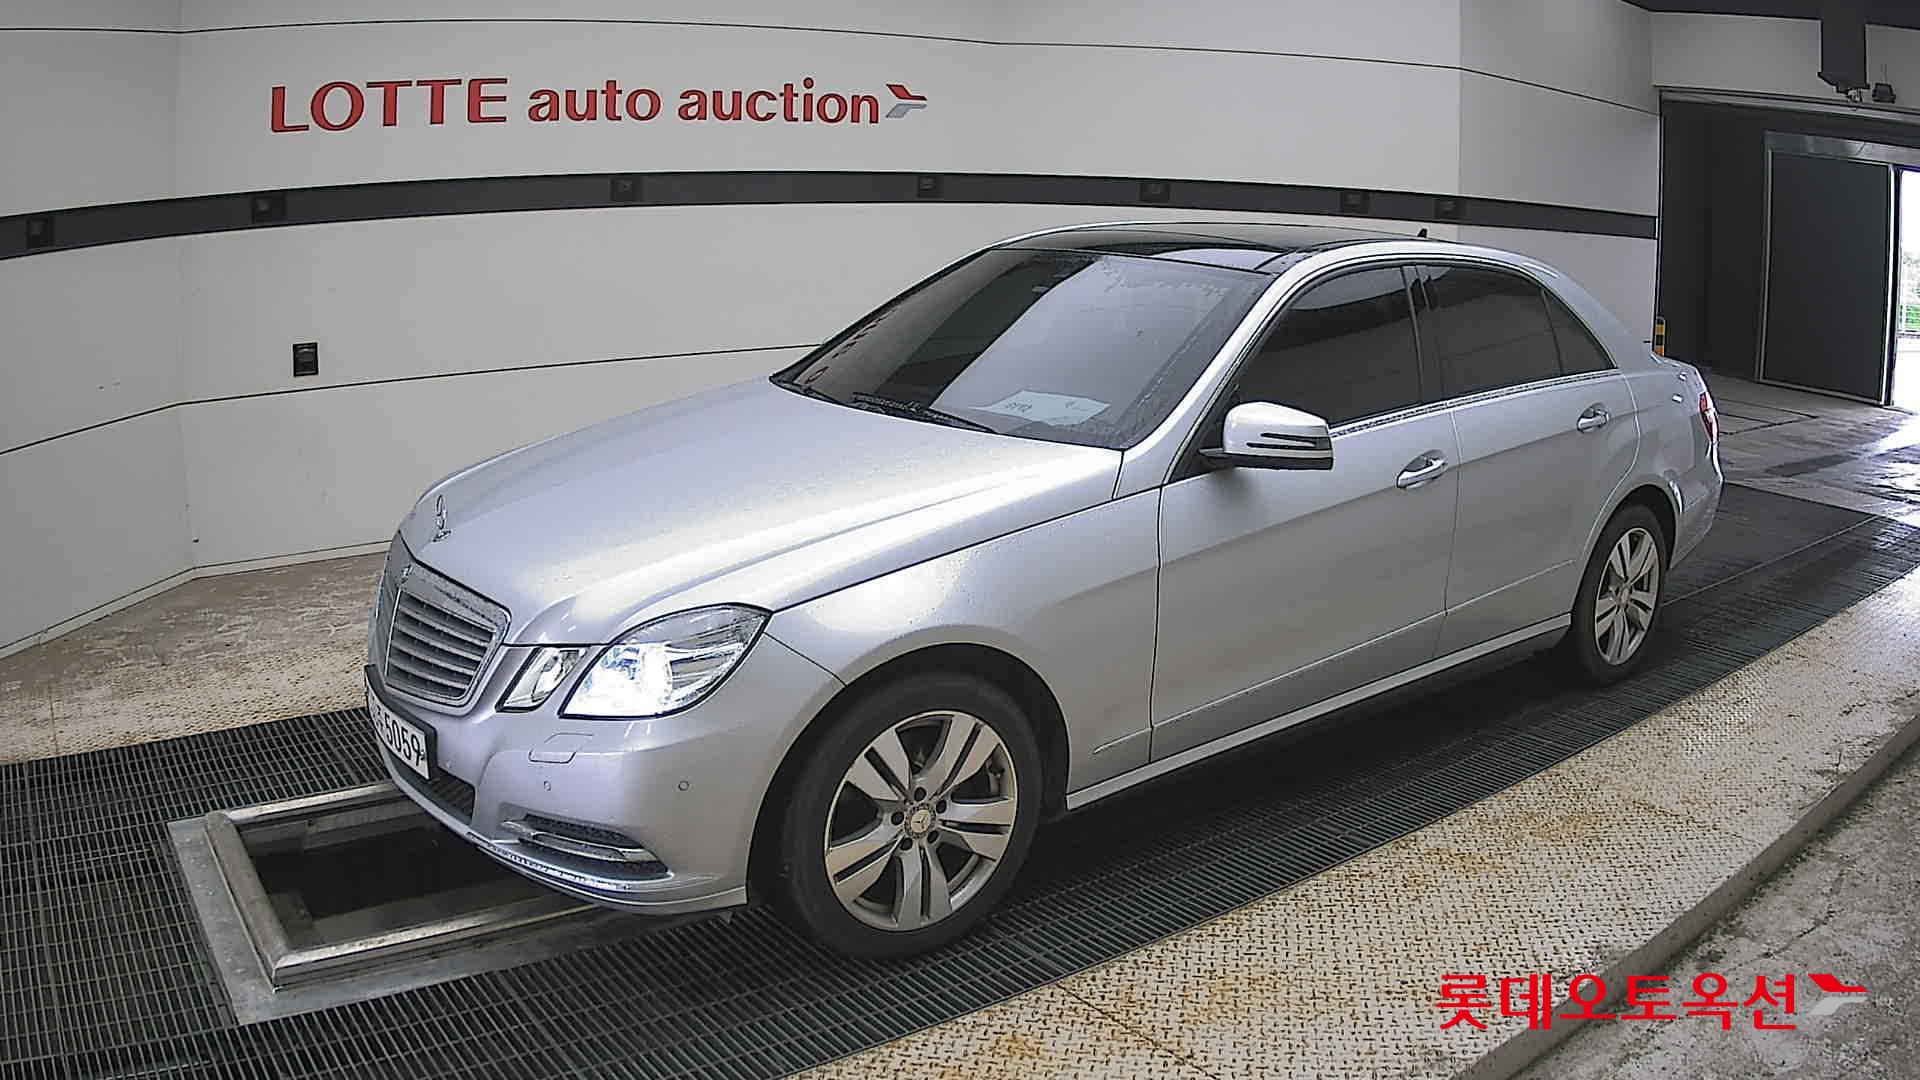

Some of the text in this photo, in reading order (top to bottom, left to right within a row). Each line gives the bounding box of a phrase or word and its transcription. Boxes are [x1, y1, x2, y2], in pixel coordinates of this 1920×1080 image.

[271, 77, 880, 132] LOTTE auto auction
